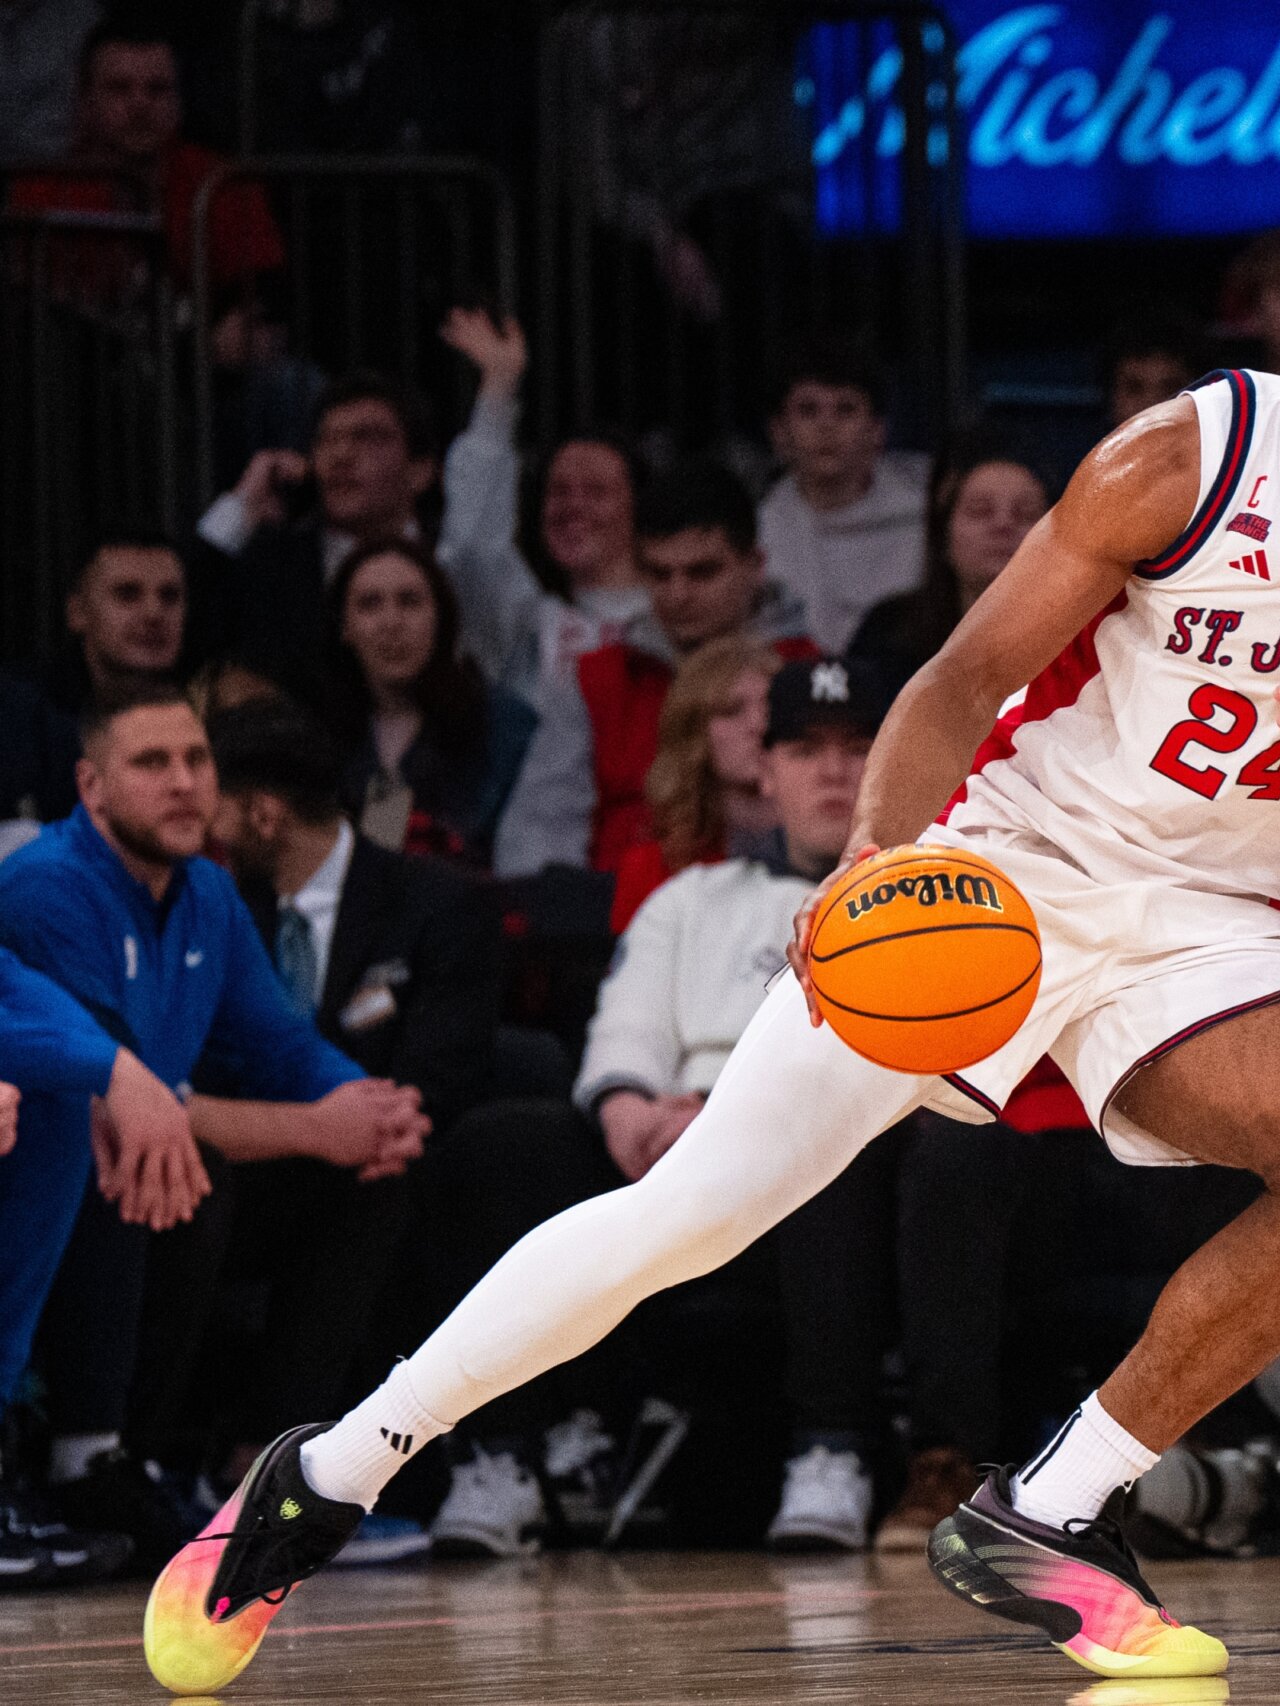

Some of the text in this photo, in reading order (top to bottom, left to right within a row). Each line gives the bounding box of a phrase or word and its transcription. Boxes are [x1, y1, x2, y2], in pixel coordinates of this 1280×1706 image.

[1247, 475, 1269, 508] C
[1164, 606, 1245, 667] ST.
[845, 872, 1003, 920] Wilson
